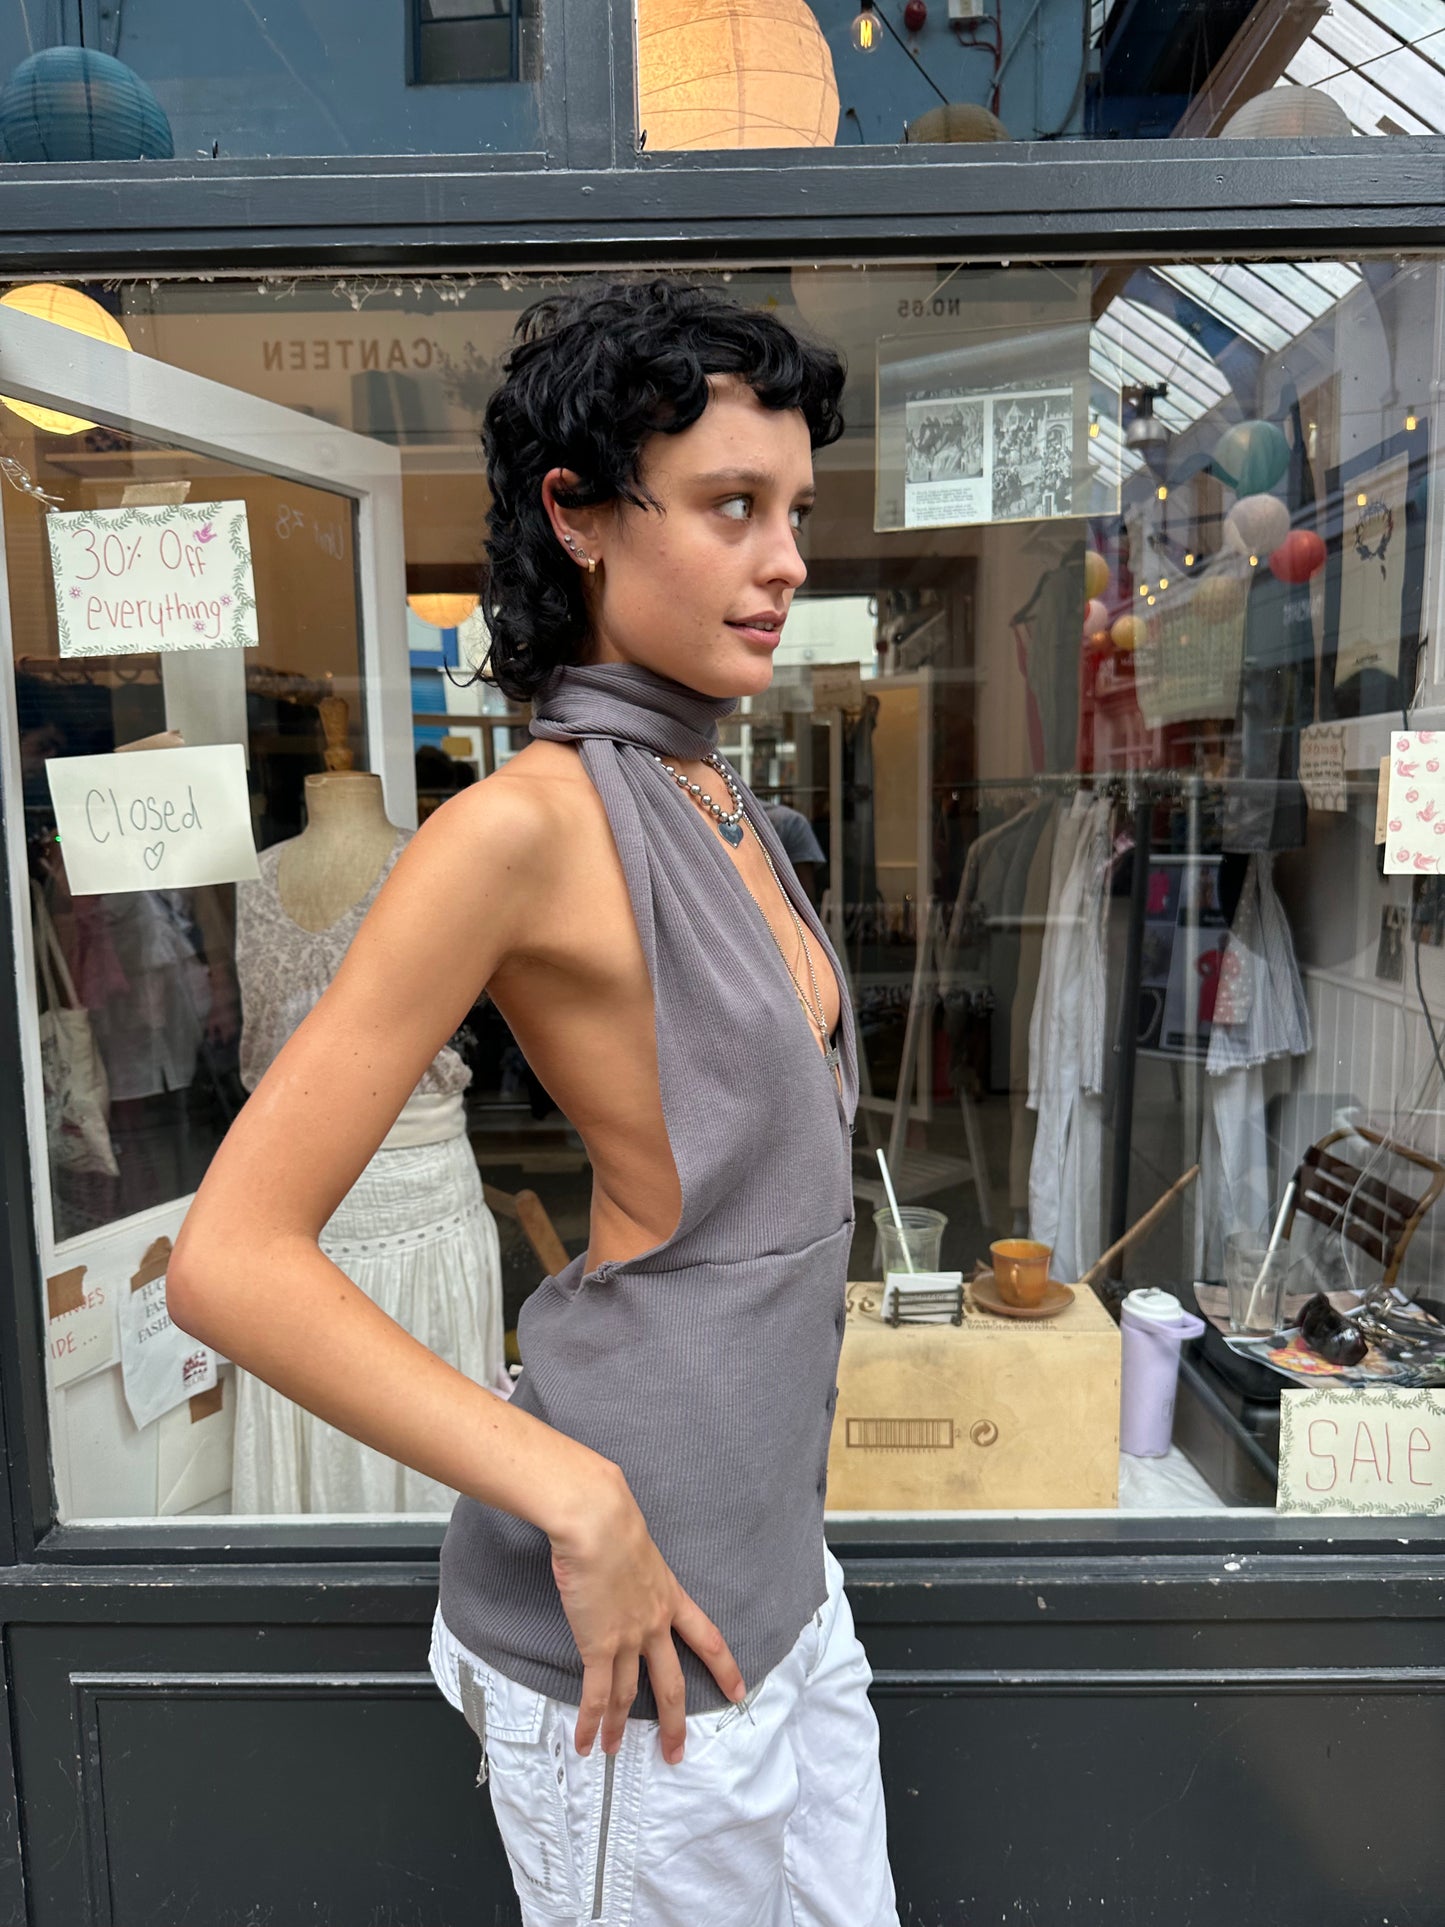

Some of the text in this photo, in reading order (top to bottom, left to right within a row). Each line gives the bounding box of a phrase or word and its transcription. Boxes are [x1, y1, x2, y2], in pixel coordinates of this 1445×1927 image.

[72, 529, 207, 581] 30% Off
[86, 593, 222, 640] everything
[85, 785, 202, 843] Closed
[145, 1297, 167, 1318] FAS
